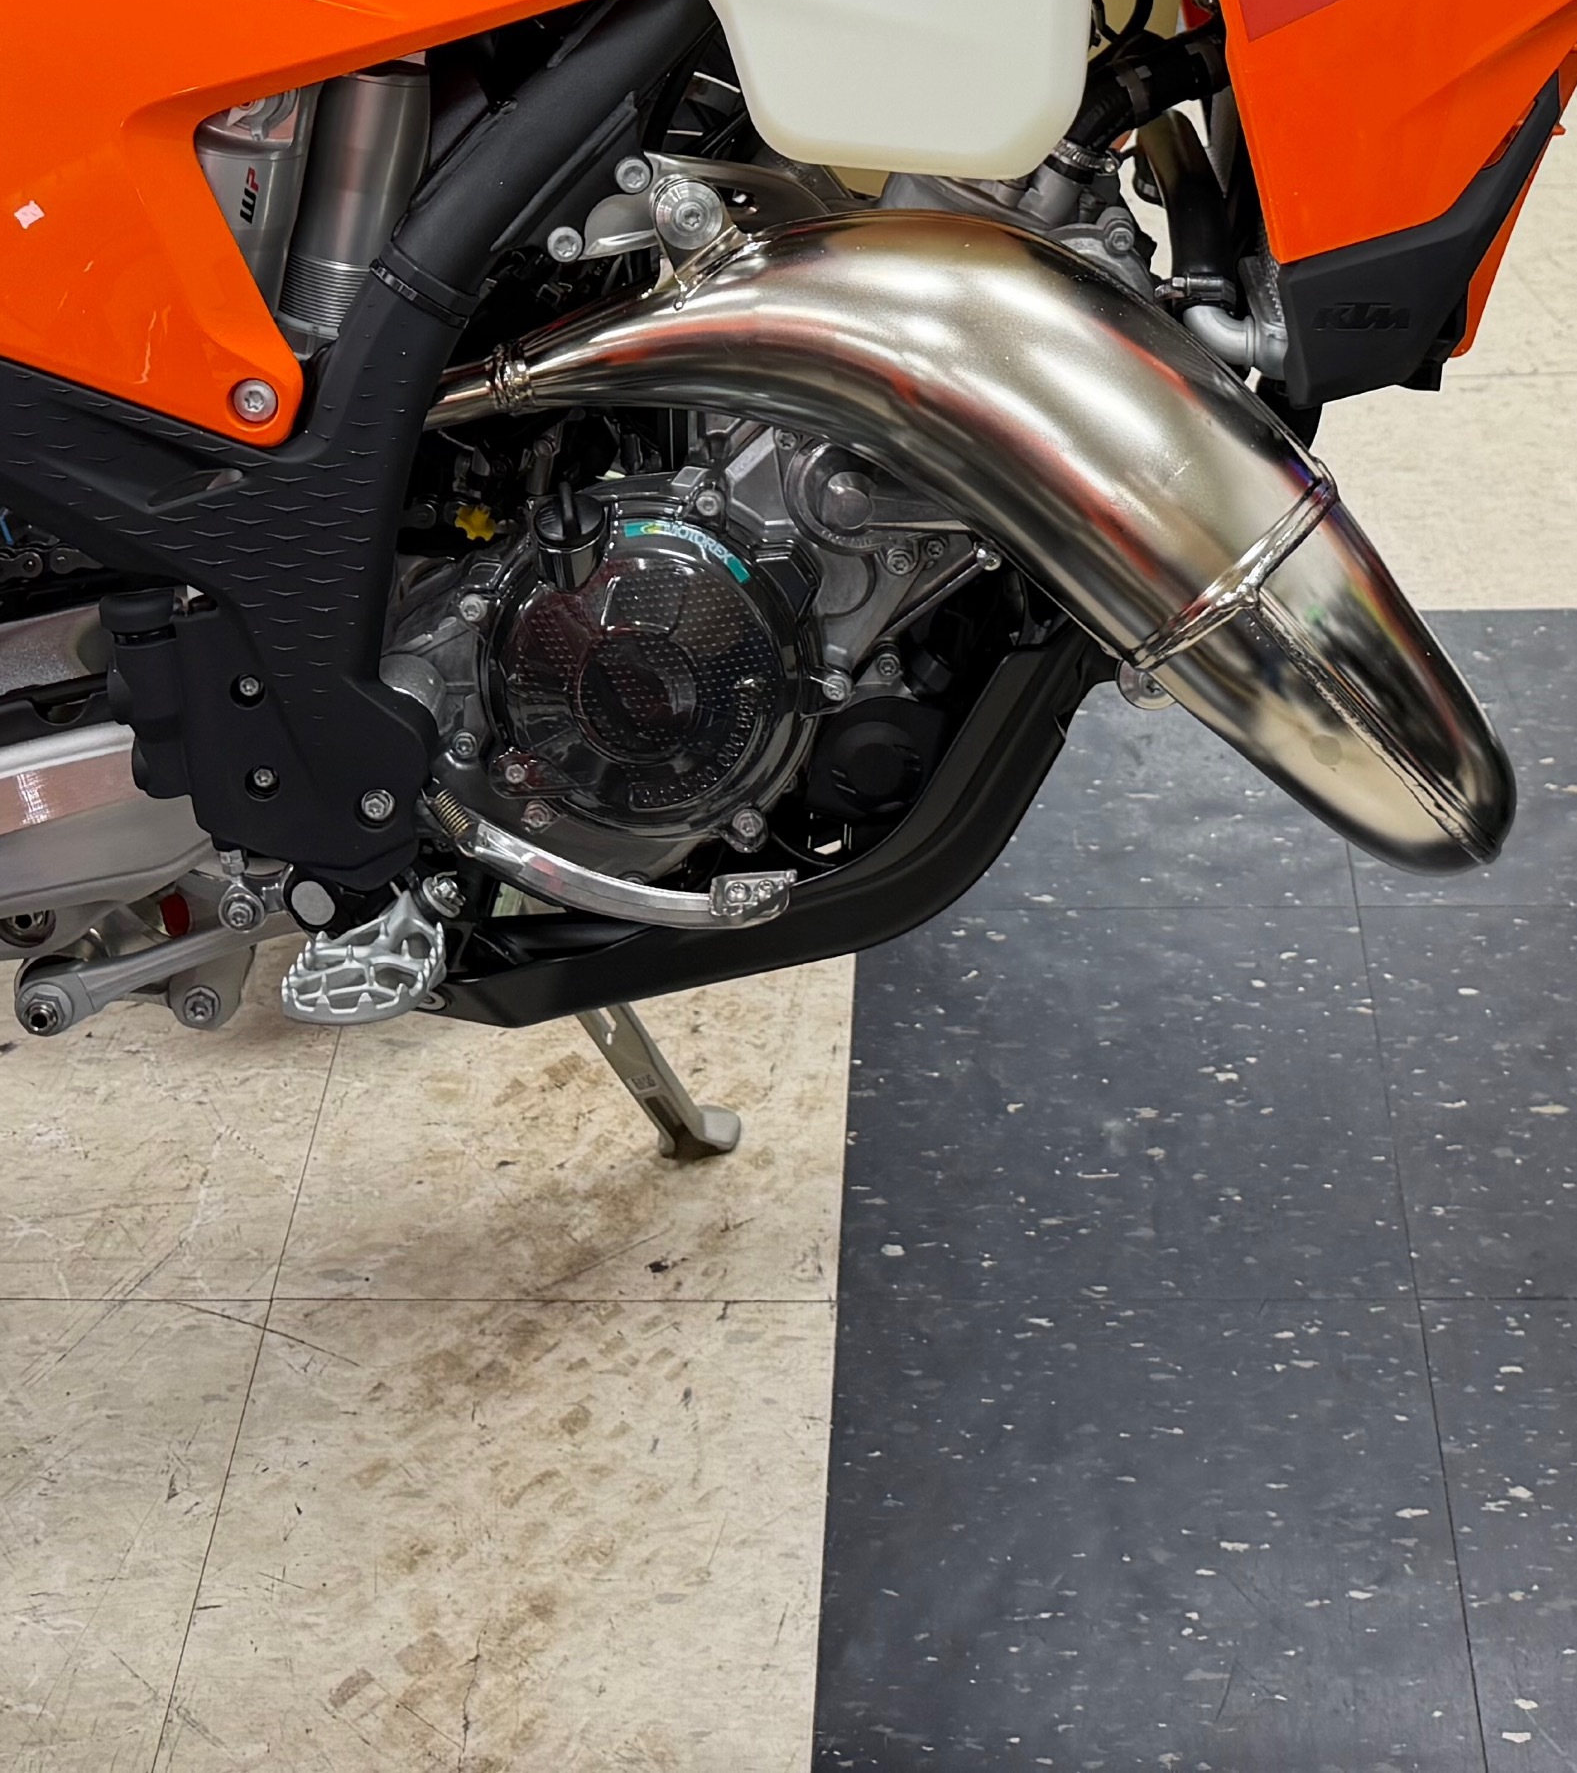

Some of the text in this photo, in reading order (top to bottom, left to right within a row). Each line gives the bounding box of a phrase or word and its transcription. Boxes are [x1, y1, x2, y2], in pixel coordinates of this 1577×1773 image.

[239, 166, 260, 224] WP
[1312, 301, 1409, 331] KTM
[663, 522, 734, 566] MOTOREX
